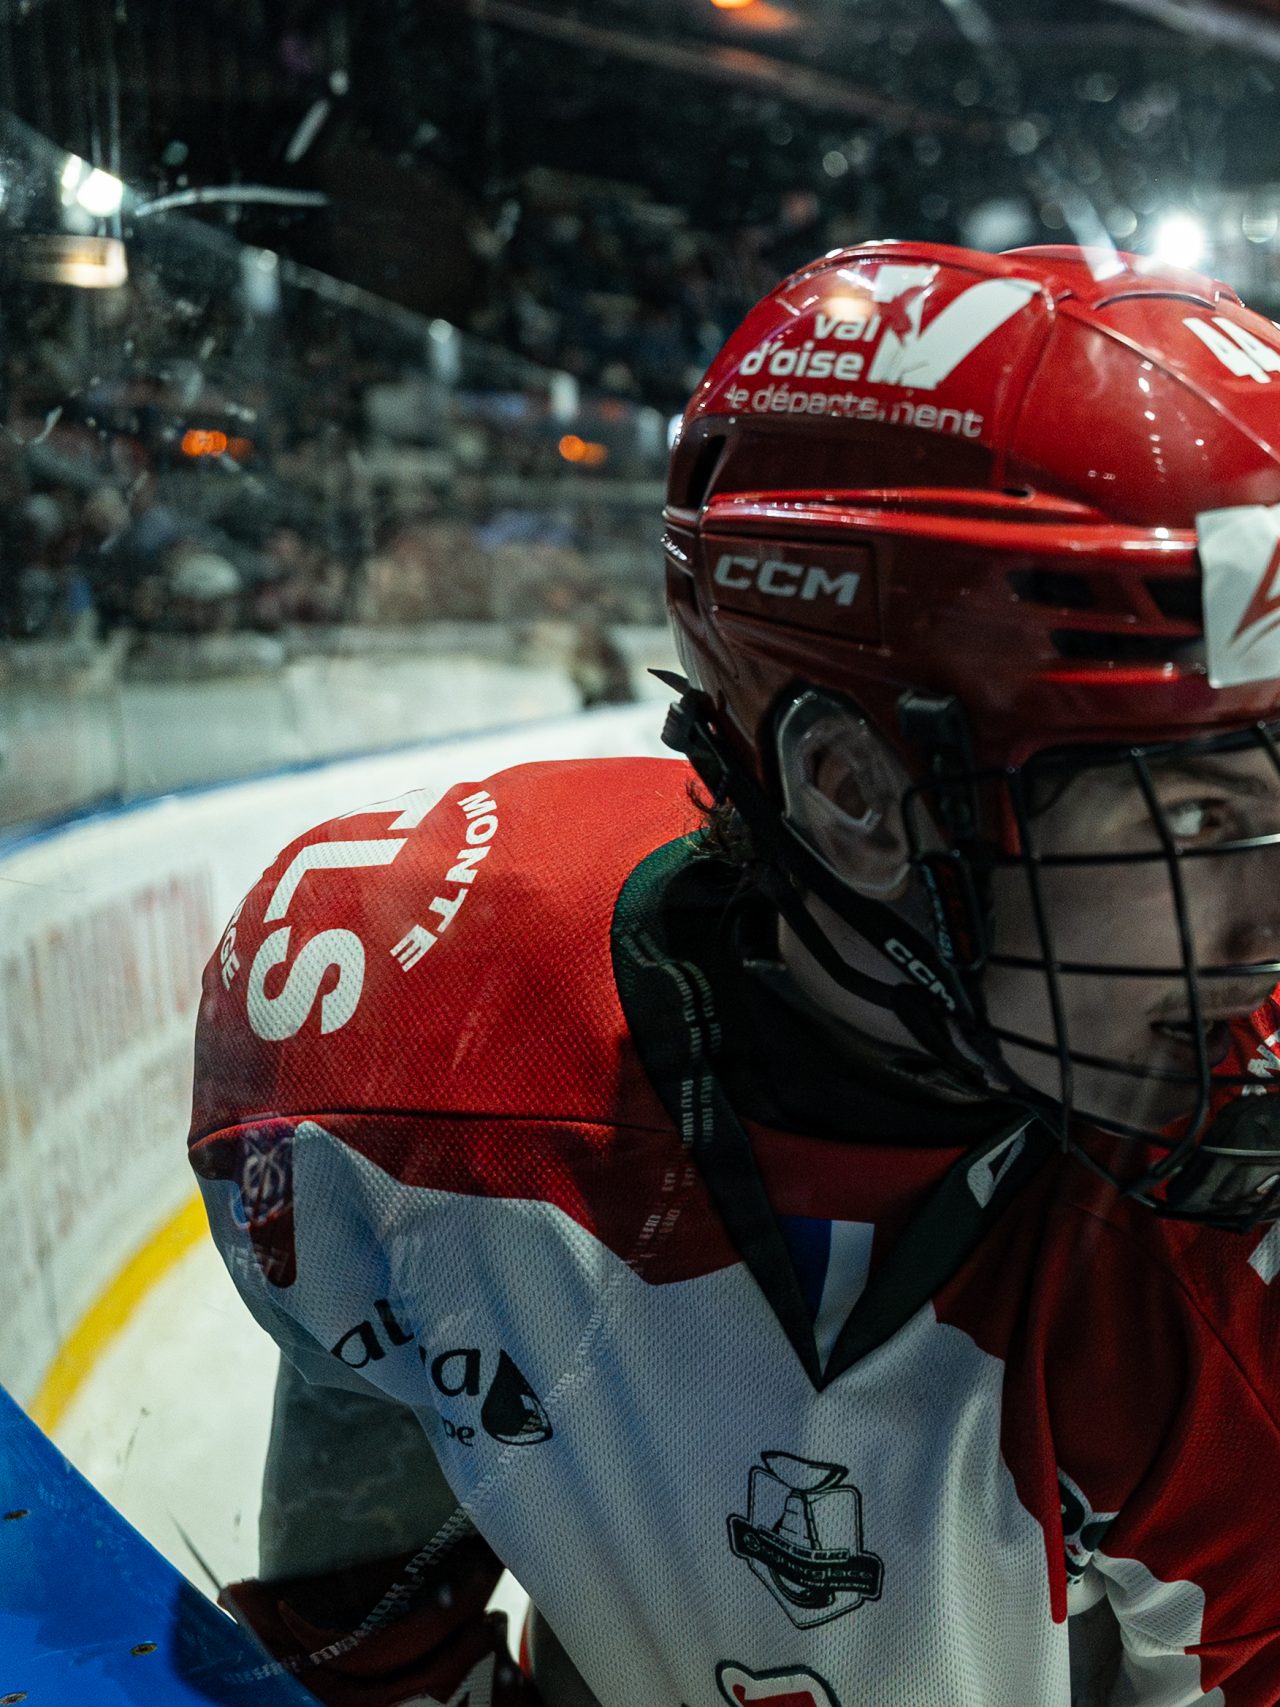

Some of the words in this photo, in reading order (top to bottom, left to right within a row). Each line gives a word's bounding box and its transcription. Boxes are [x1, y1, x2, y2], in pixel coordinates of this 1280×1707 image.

[814, 310, 881, 342] val
[739, 340, 865, 382] d'oise
[713, 555, 861, 607] CCM
[389, 790, 499, 973] MONTE
[883, 937, 956, 1013] CCM
